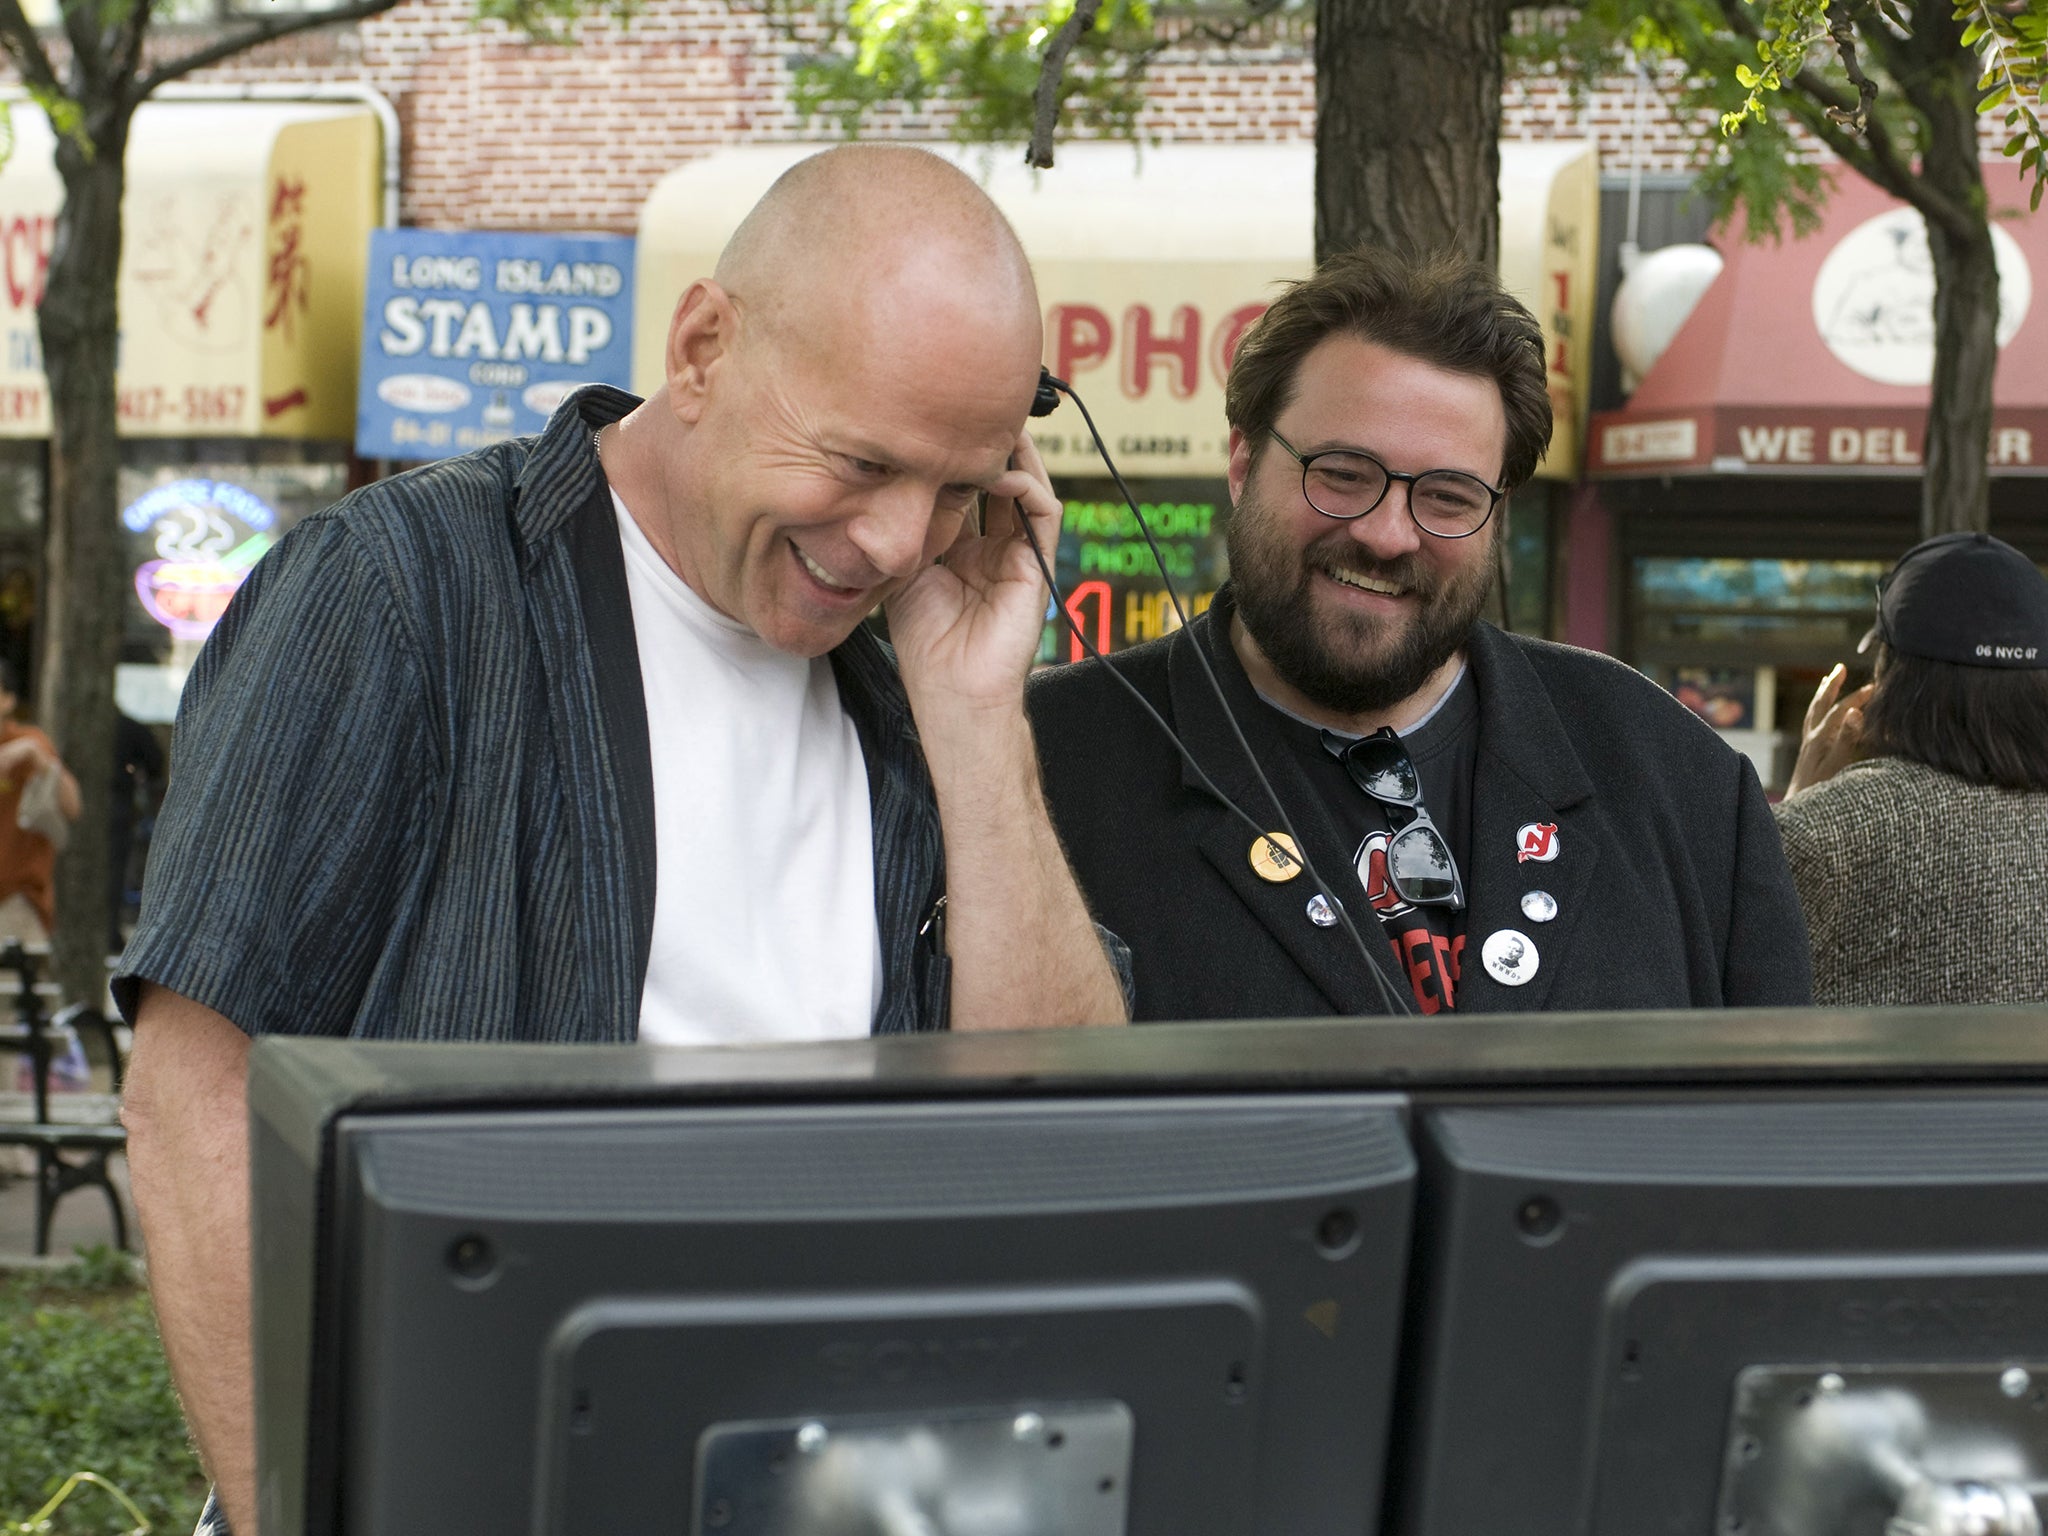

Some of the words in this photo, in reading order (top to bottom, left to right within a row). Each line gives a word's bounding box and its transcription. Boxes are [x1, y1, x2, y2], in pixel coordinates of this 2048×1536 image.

[392, 254, 481, 291] LONG
[496, 258, 622, 297] ISLAND
[380, 297, 613, 364] STAMP
[1116, 434, 1191, 456] CARDS
[1738, 426, 1814, 463] WE
[1828, 426, 2033, 465] DELR
[1063, 501, 1215, 538] PASSPORT
[1080, 542, 1195, 577] PHOTOS
[1976, 644, 1992, 657] 06
[1996, 646, 2023, 660] NYC
